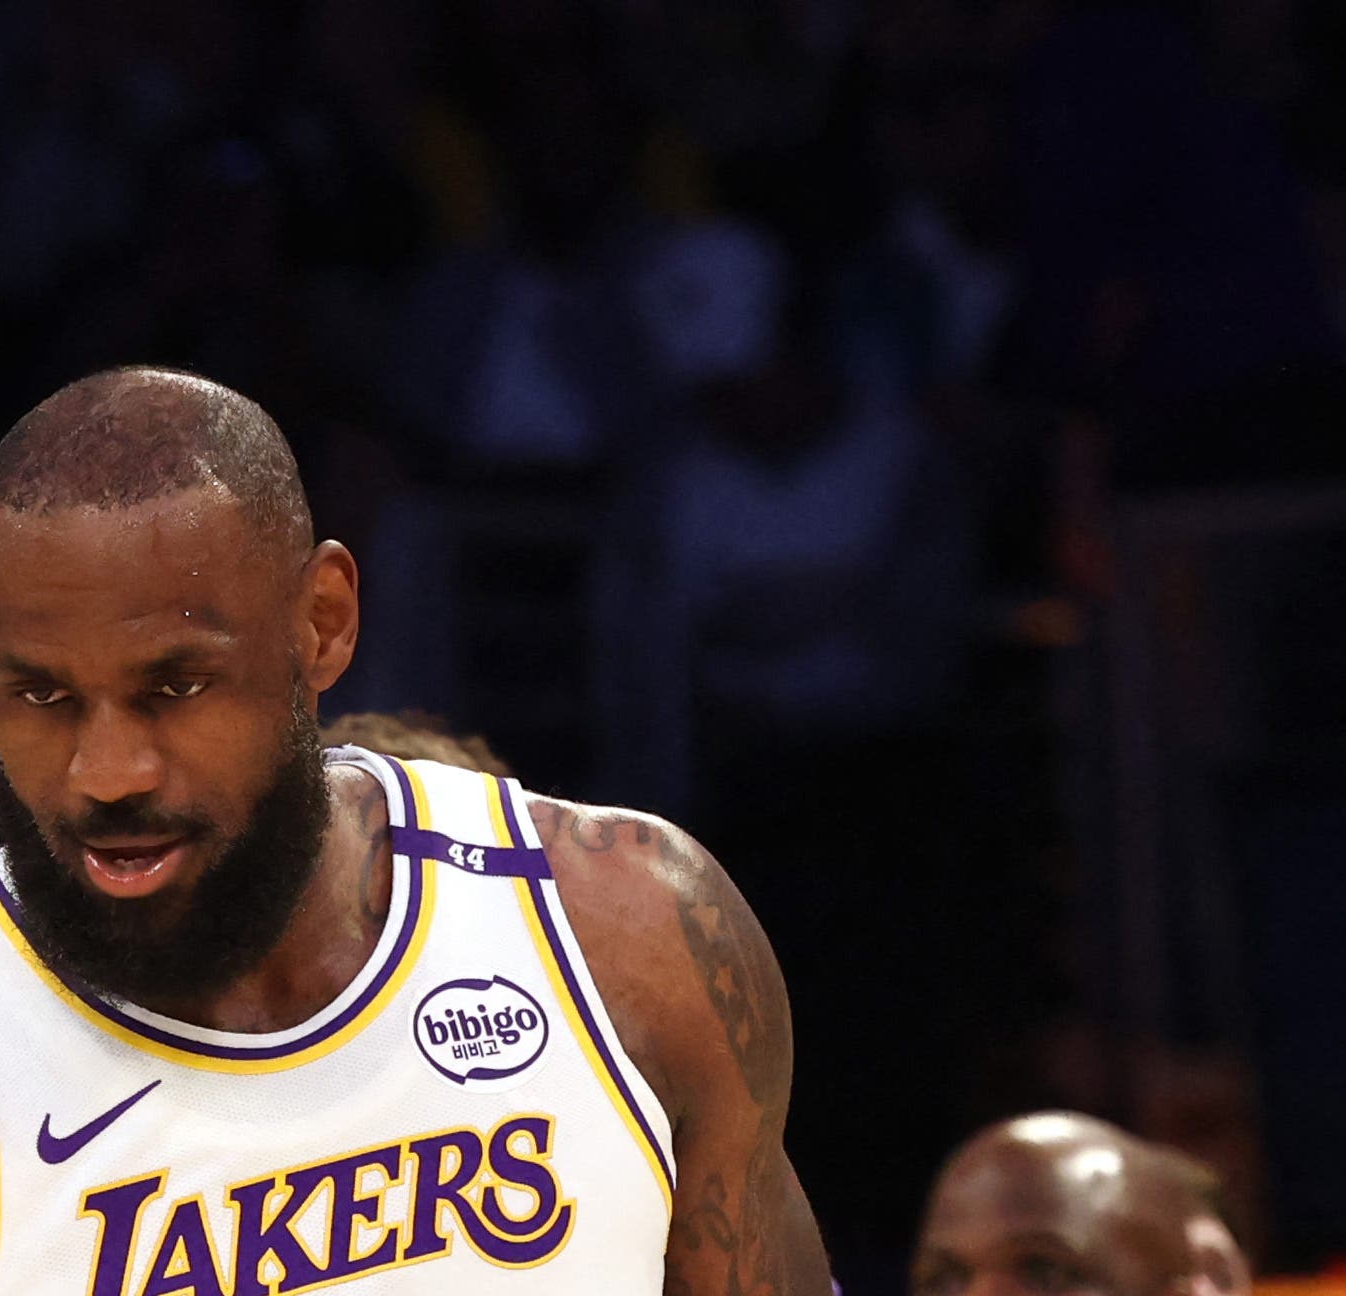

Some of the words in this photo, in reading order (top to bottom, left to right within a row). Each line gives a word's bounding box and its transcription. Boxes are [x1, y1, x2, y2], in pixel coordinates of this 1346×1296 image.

[448, 842, 485, 871] 44
[422, 1004, 538, 1045] bibigo
[451, 1039, 501, 1060] 비비고
